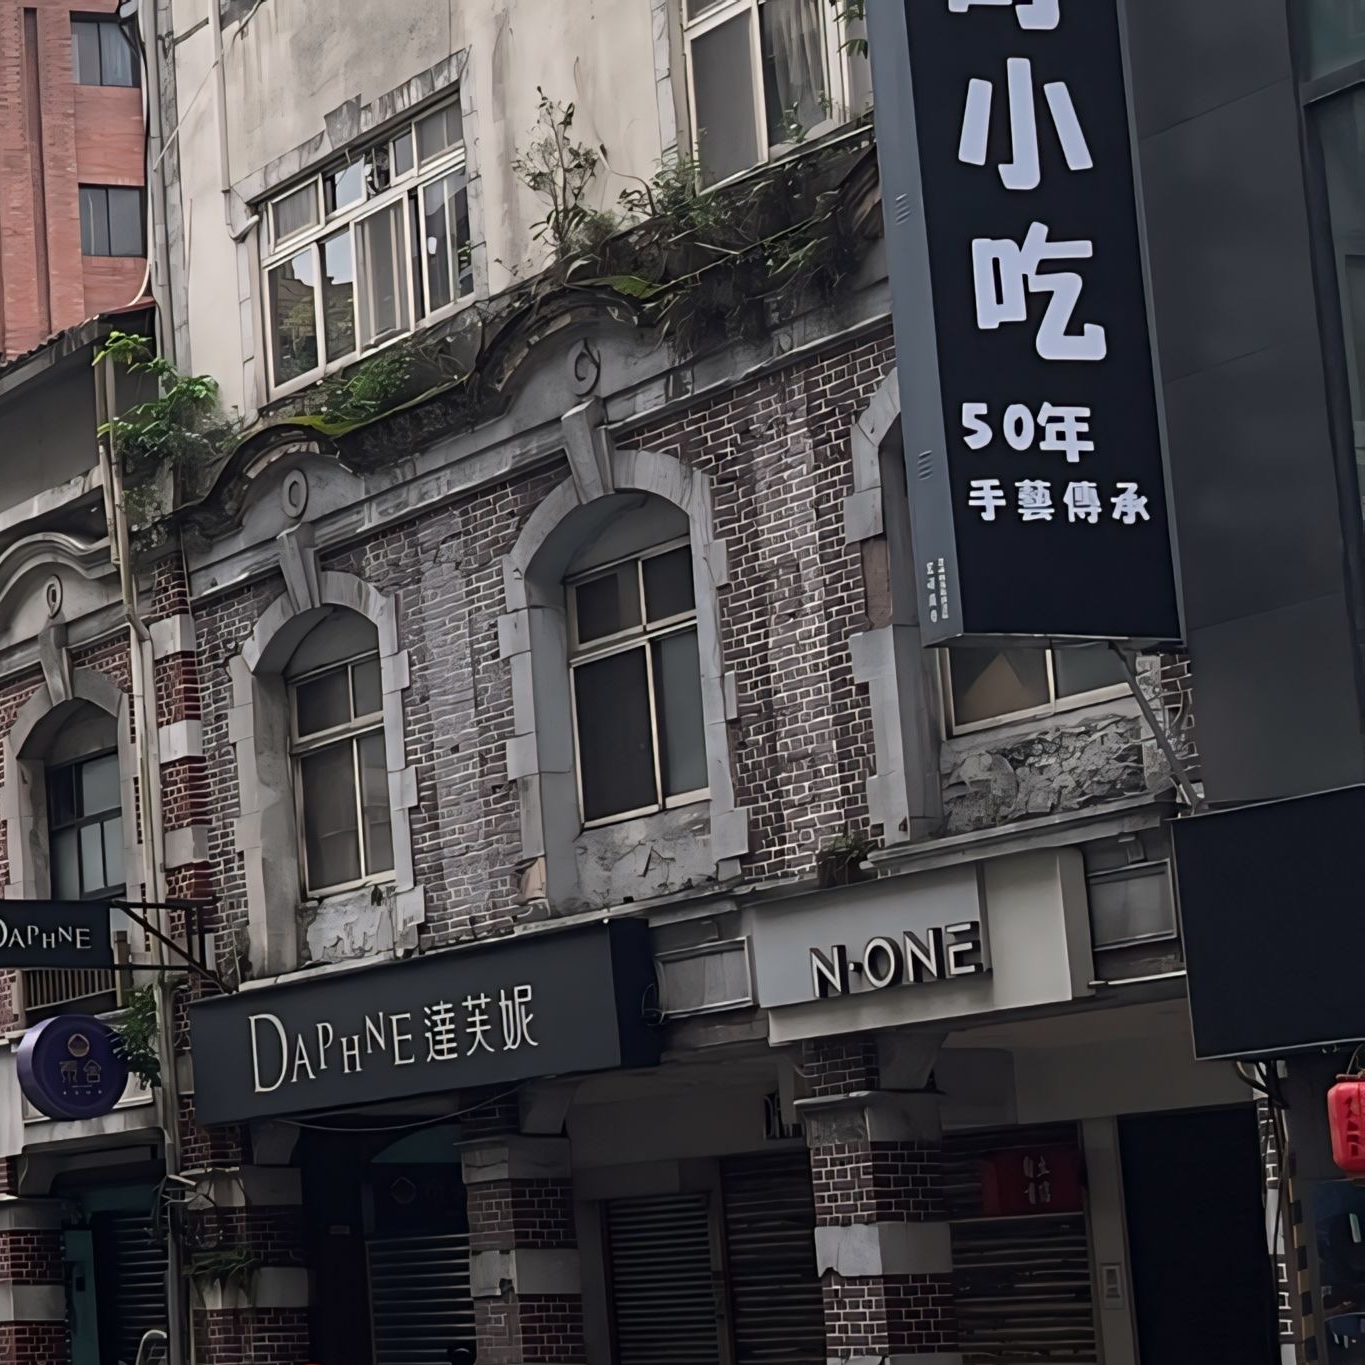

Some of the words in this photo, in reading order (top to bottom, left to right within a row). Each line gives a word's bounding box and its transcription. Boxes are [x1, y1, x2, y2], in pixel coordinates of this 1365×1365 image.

[948, 0, 1107, 360] 小吃
[962, 401, 1095, 462] 50年
[969, 479, 1150, 525] 手藝傳承
[248, 1011, 416, 1093] DAPHNE
[423, 984, 540, 1063] 達芙妮
